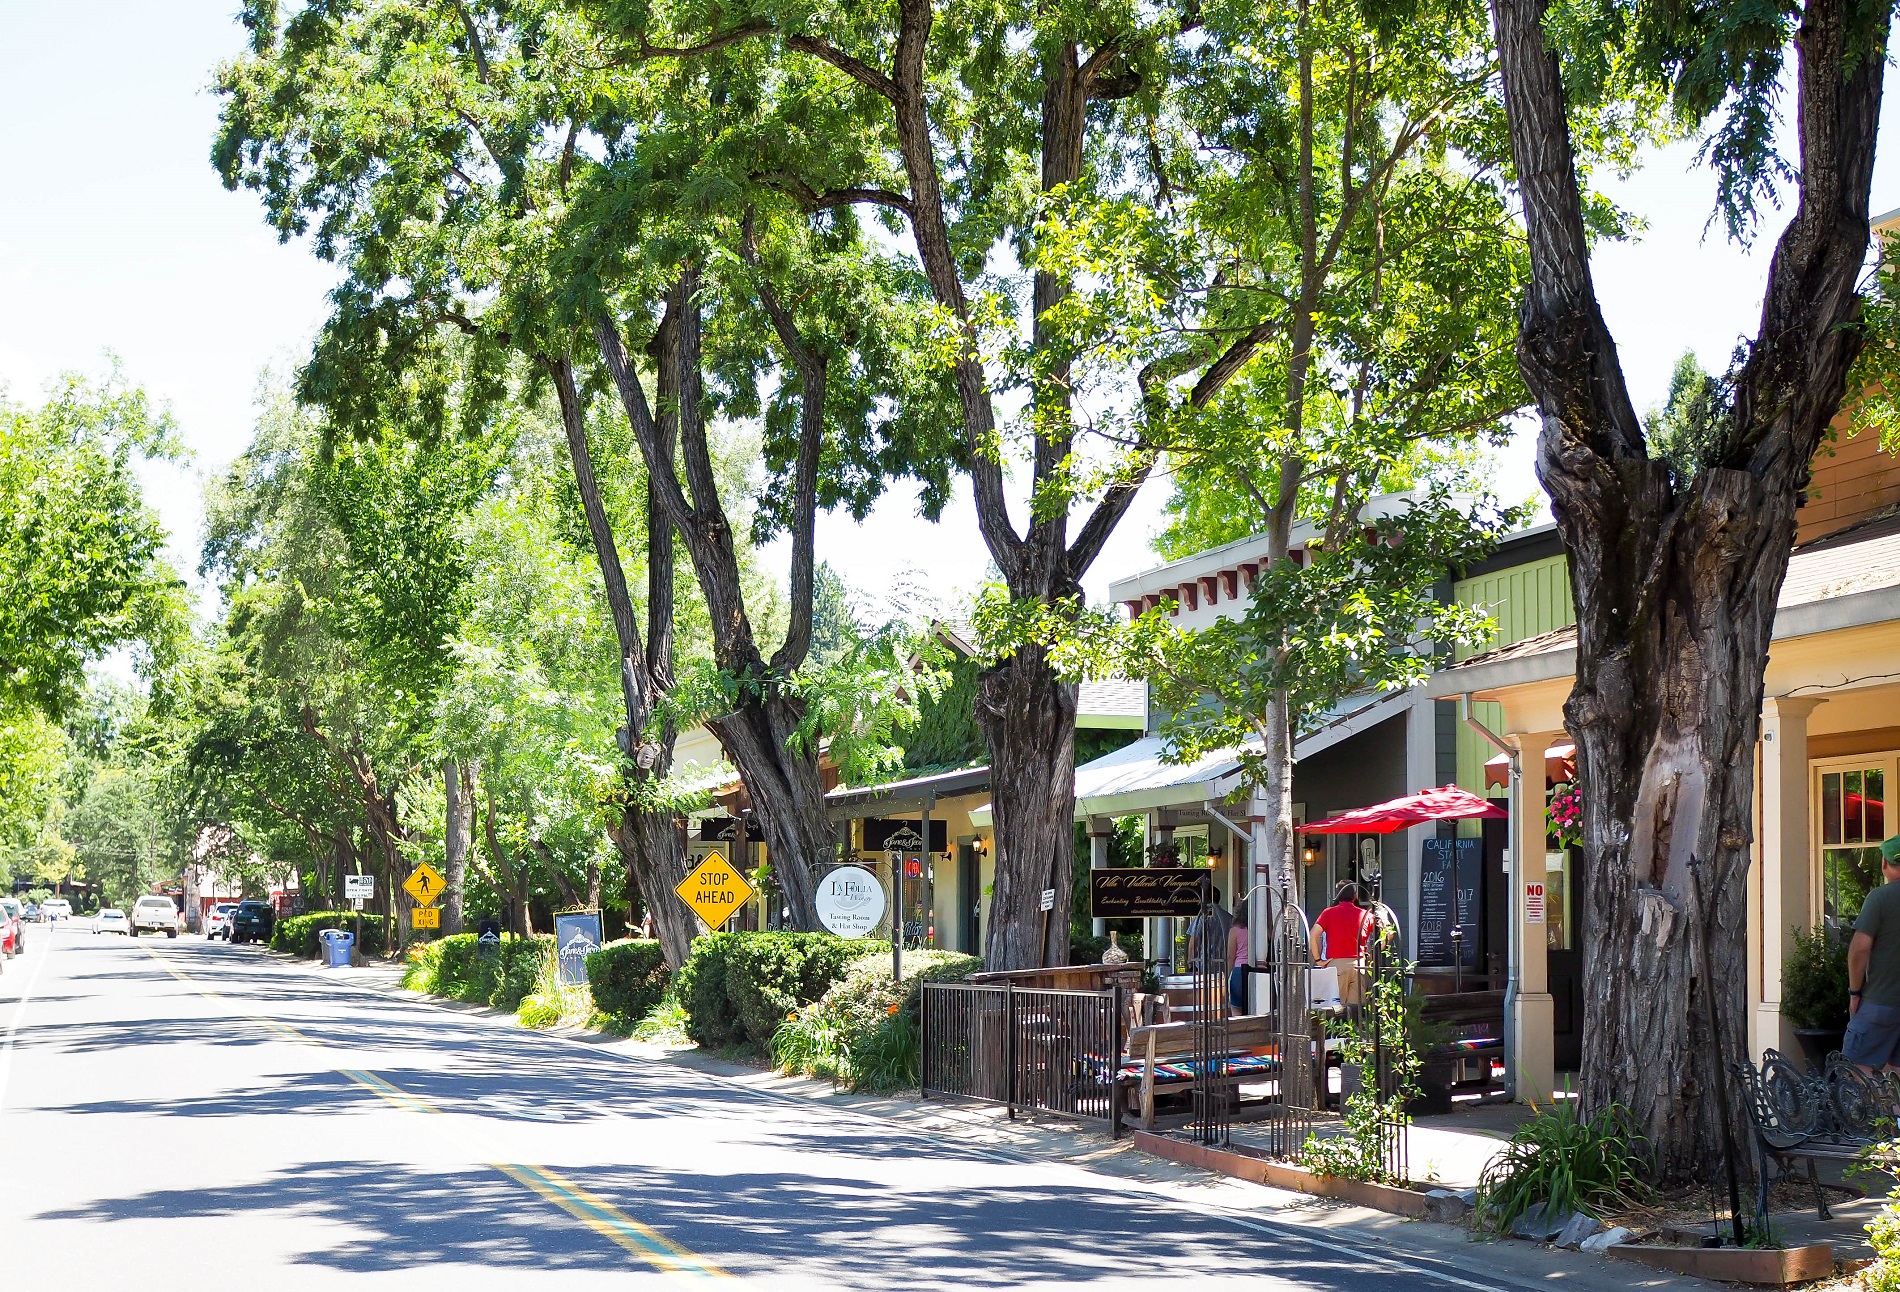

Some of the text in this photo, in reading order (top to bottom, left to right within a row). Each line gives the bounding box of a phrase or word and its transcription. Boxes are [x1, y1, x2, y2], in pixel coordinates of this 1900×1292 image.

[1442, 861, 1461, 870] FAR
[700, 873, 730, 886] STOP
[1096, 876, 1124, 889] Villa
[1159, 874, 1201, 892] Vineyards
[1422, 871, 1445, 883] 2016
[1456, 889, 1475, 901] 017
[1526, 884, 1544, 897] NO
[695, 891, 735, 904] AHEAD
[830, 912, 871, 922] Tasting Room
[852, 923, 868, 931] Shop
[1420, 920, 1443, 931] 2018
